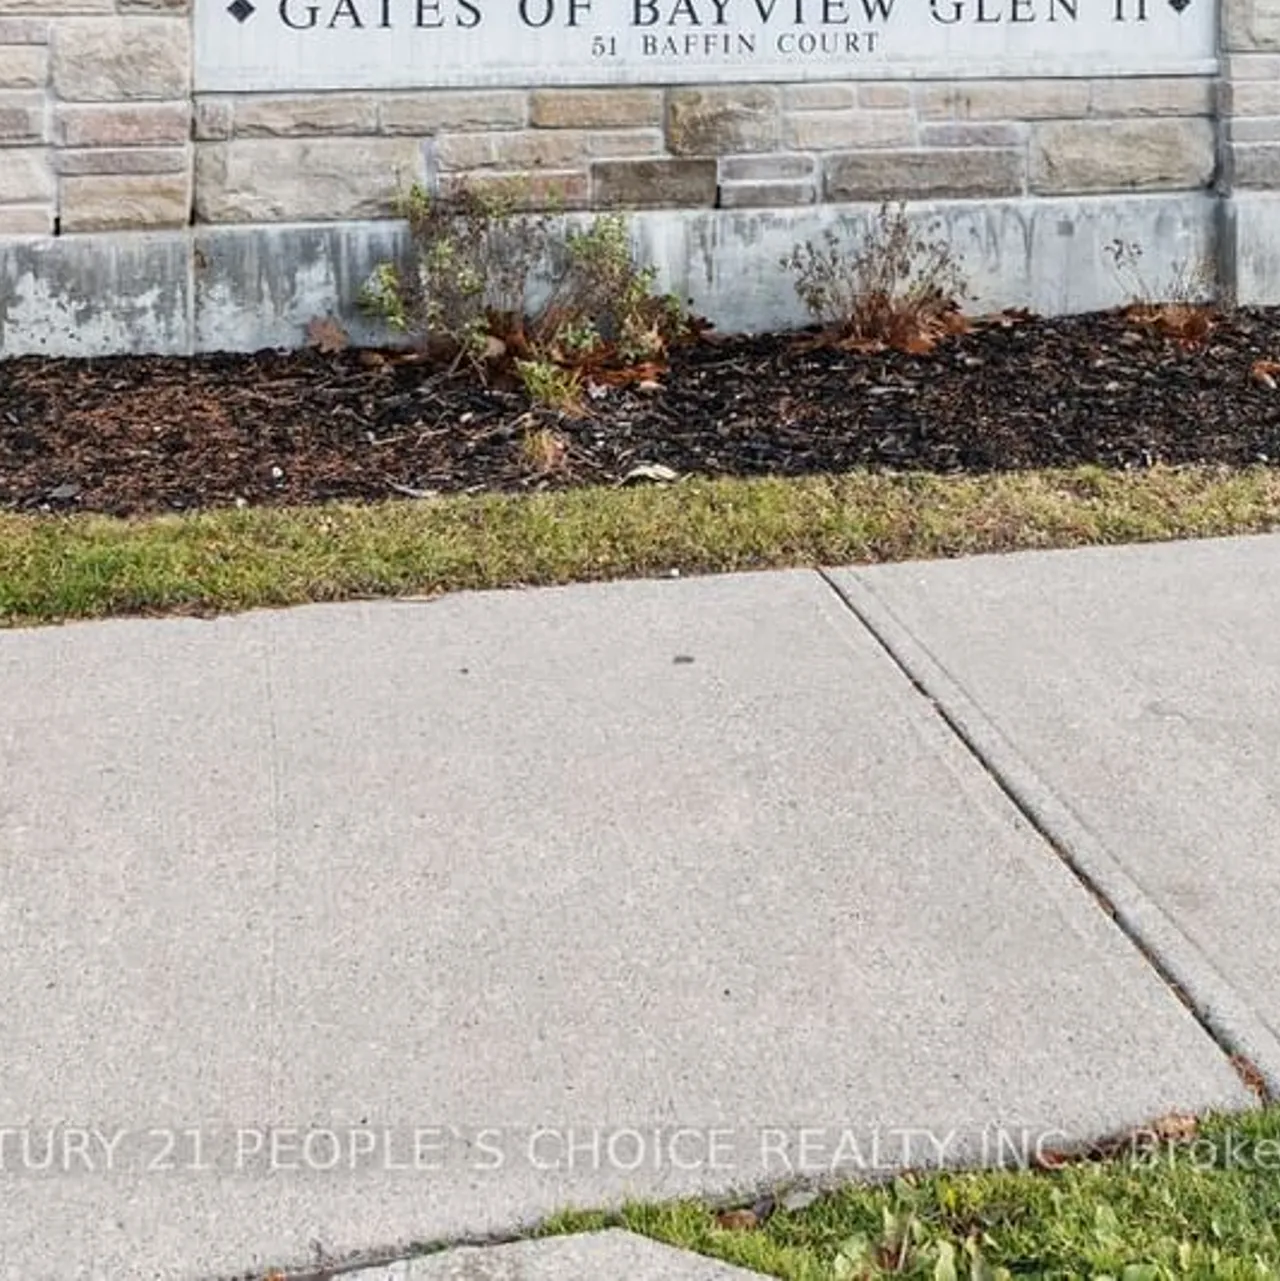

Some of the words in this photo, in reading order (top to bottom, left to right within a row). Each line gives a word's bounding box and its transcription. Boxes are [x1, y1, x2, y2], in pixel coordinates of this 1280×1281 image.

[591, 35, 617, 56] 51
[642, 33, 756, 55] BAFFIN
[777, 32, 880, 53] COURT
